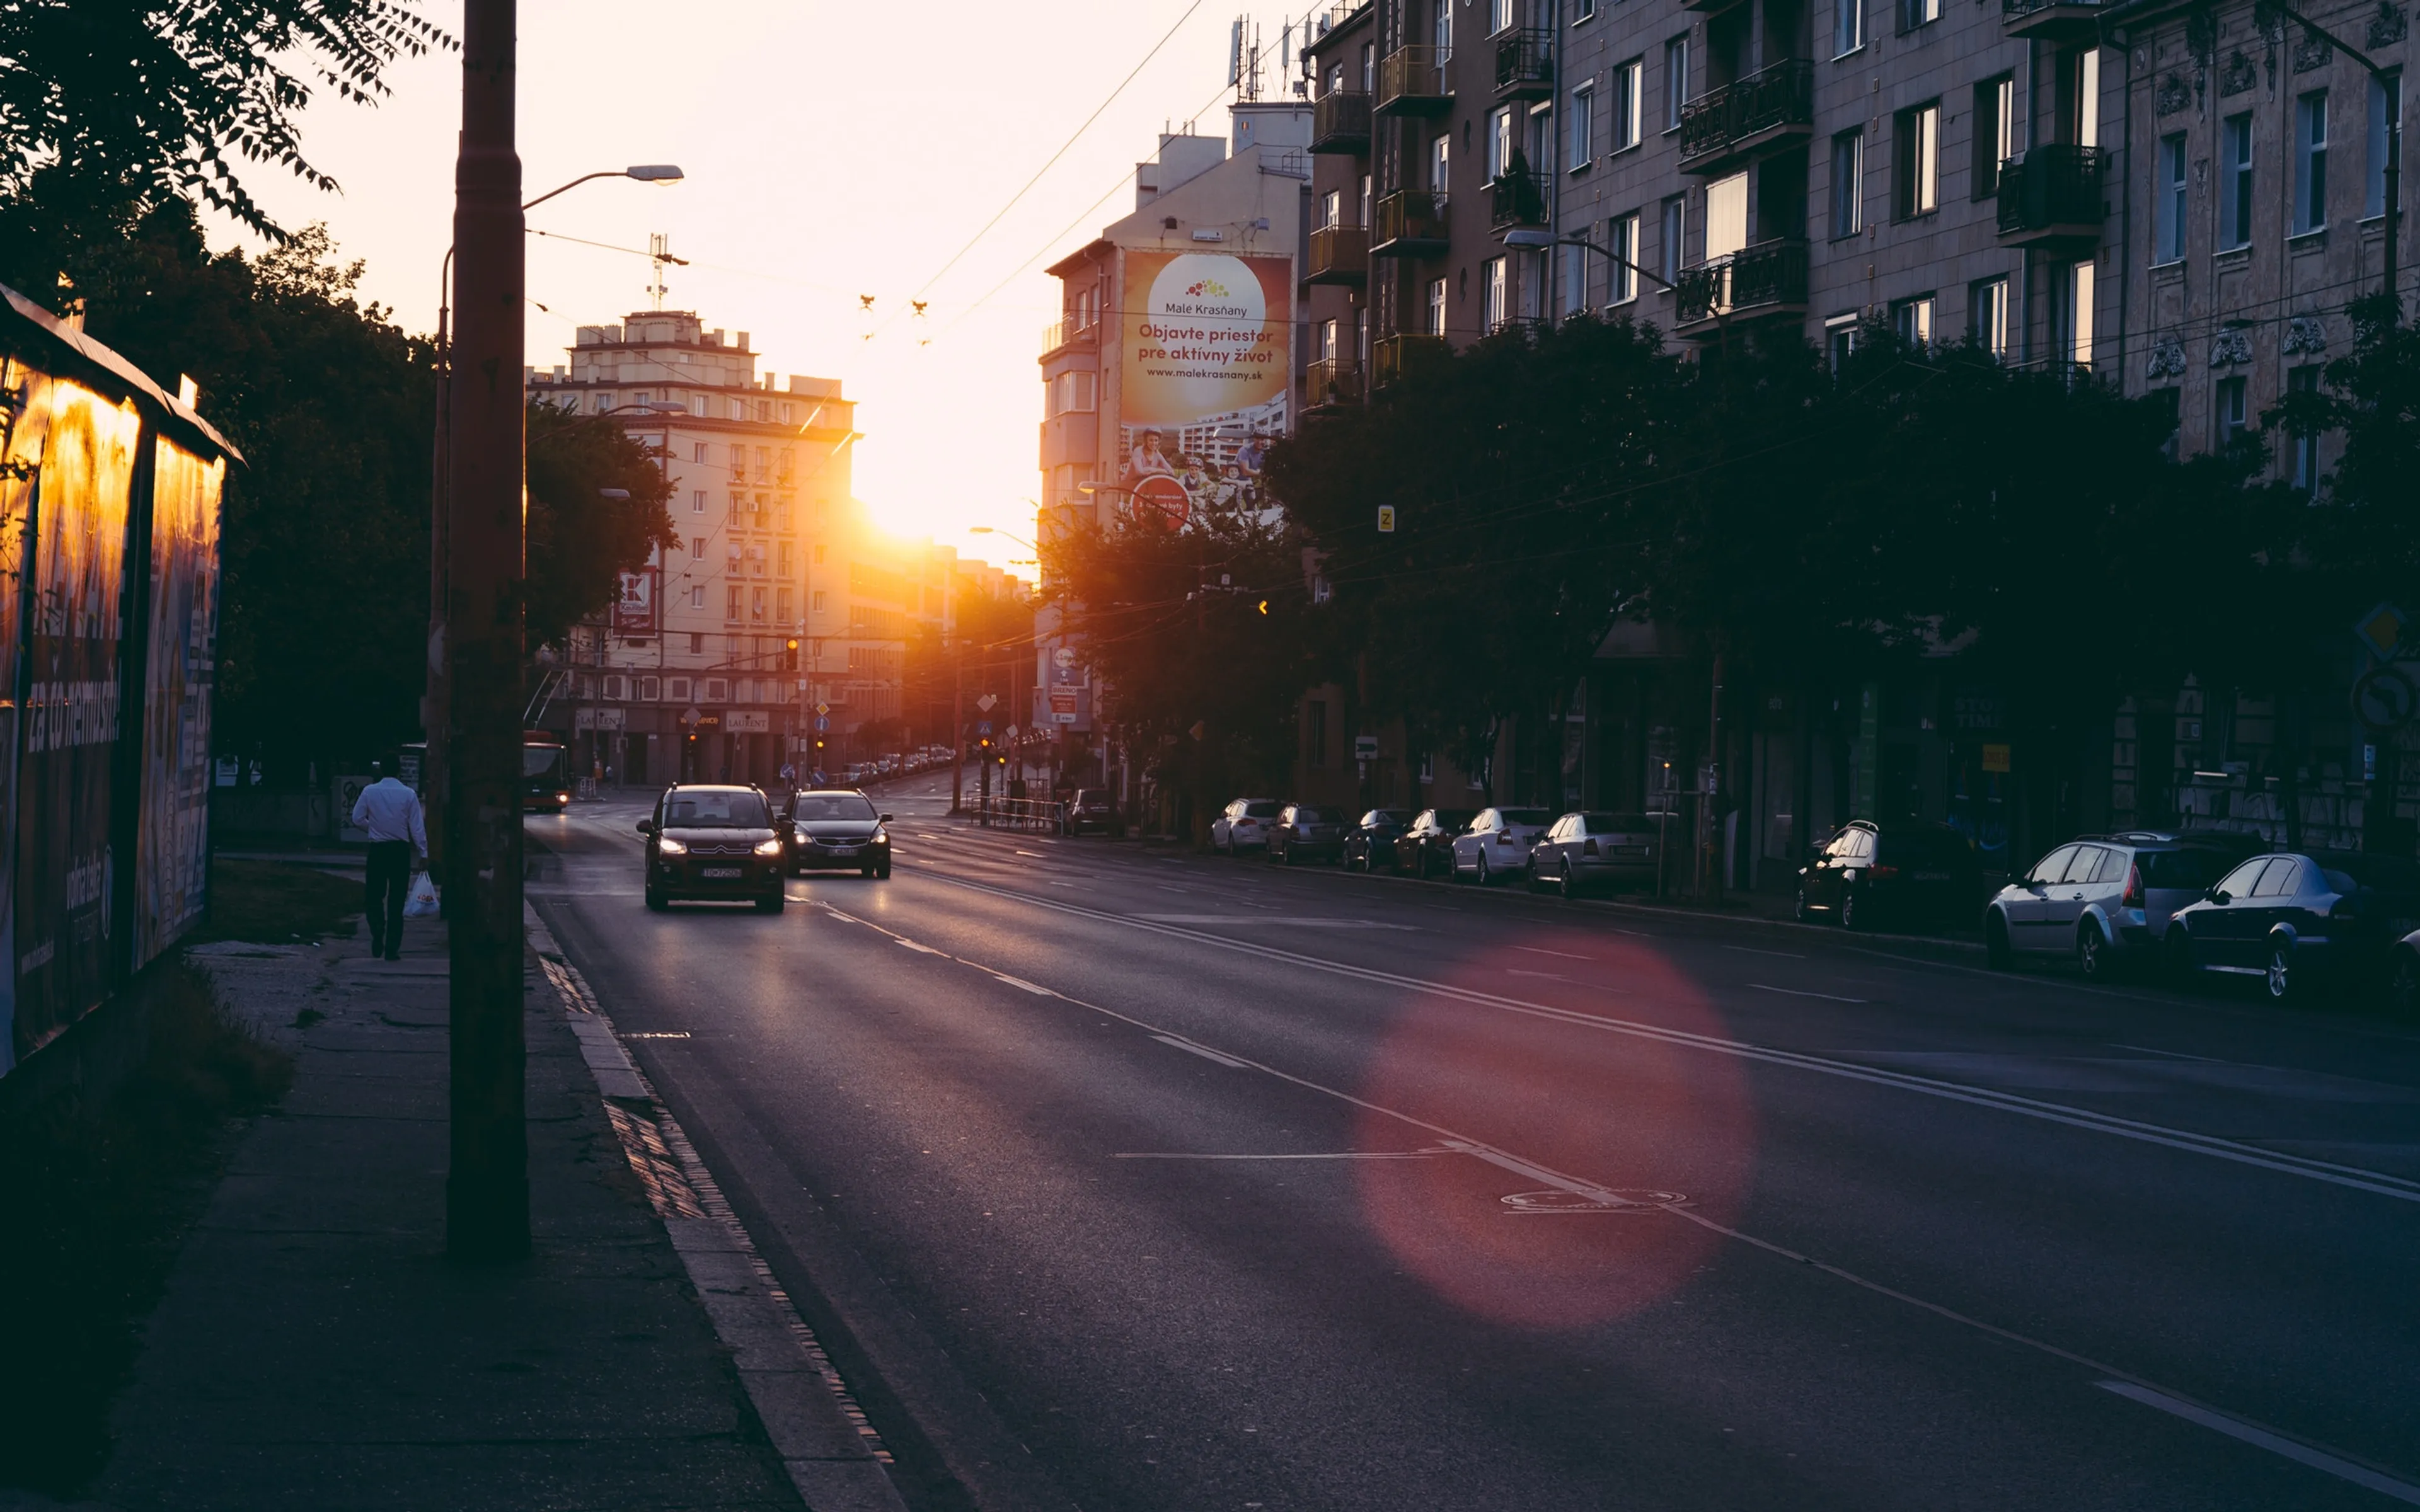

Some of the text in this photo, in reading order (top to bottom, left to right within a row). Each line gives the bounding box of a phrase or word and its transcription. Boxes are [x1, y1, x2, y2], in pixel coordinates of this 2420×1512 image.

[1139, 323, 1274, 345] Objavte priestor
[1138, 346, 1273, 365] pre aktívny život
[1147, 368, 1263, 382] www.malekrasnany.sk
[1382, 513, 1390, 525] Z
[1954, 697, 2005, 712] STO
[28, 681, 45, 753] za
[729, 719, 766, 727] LAURENT
